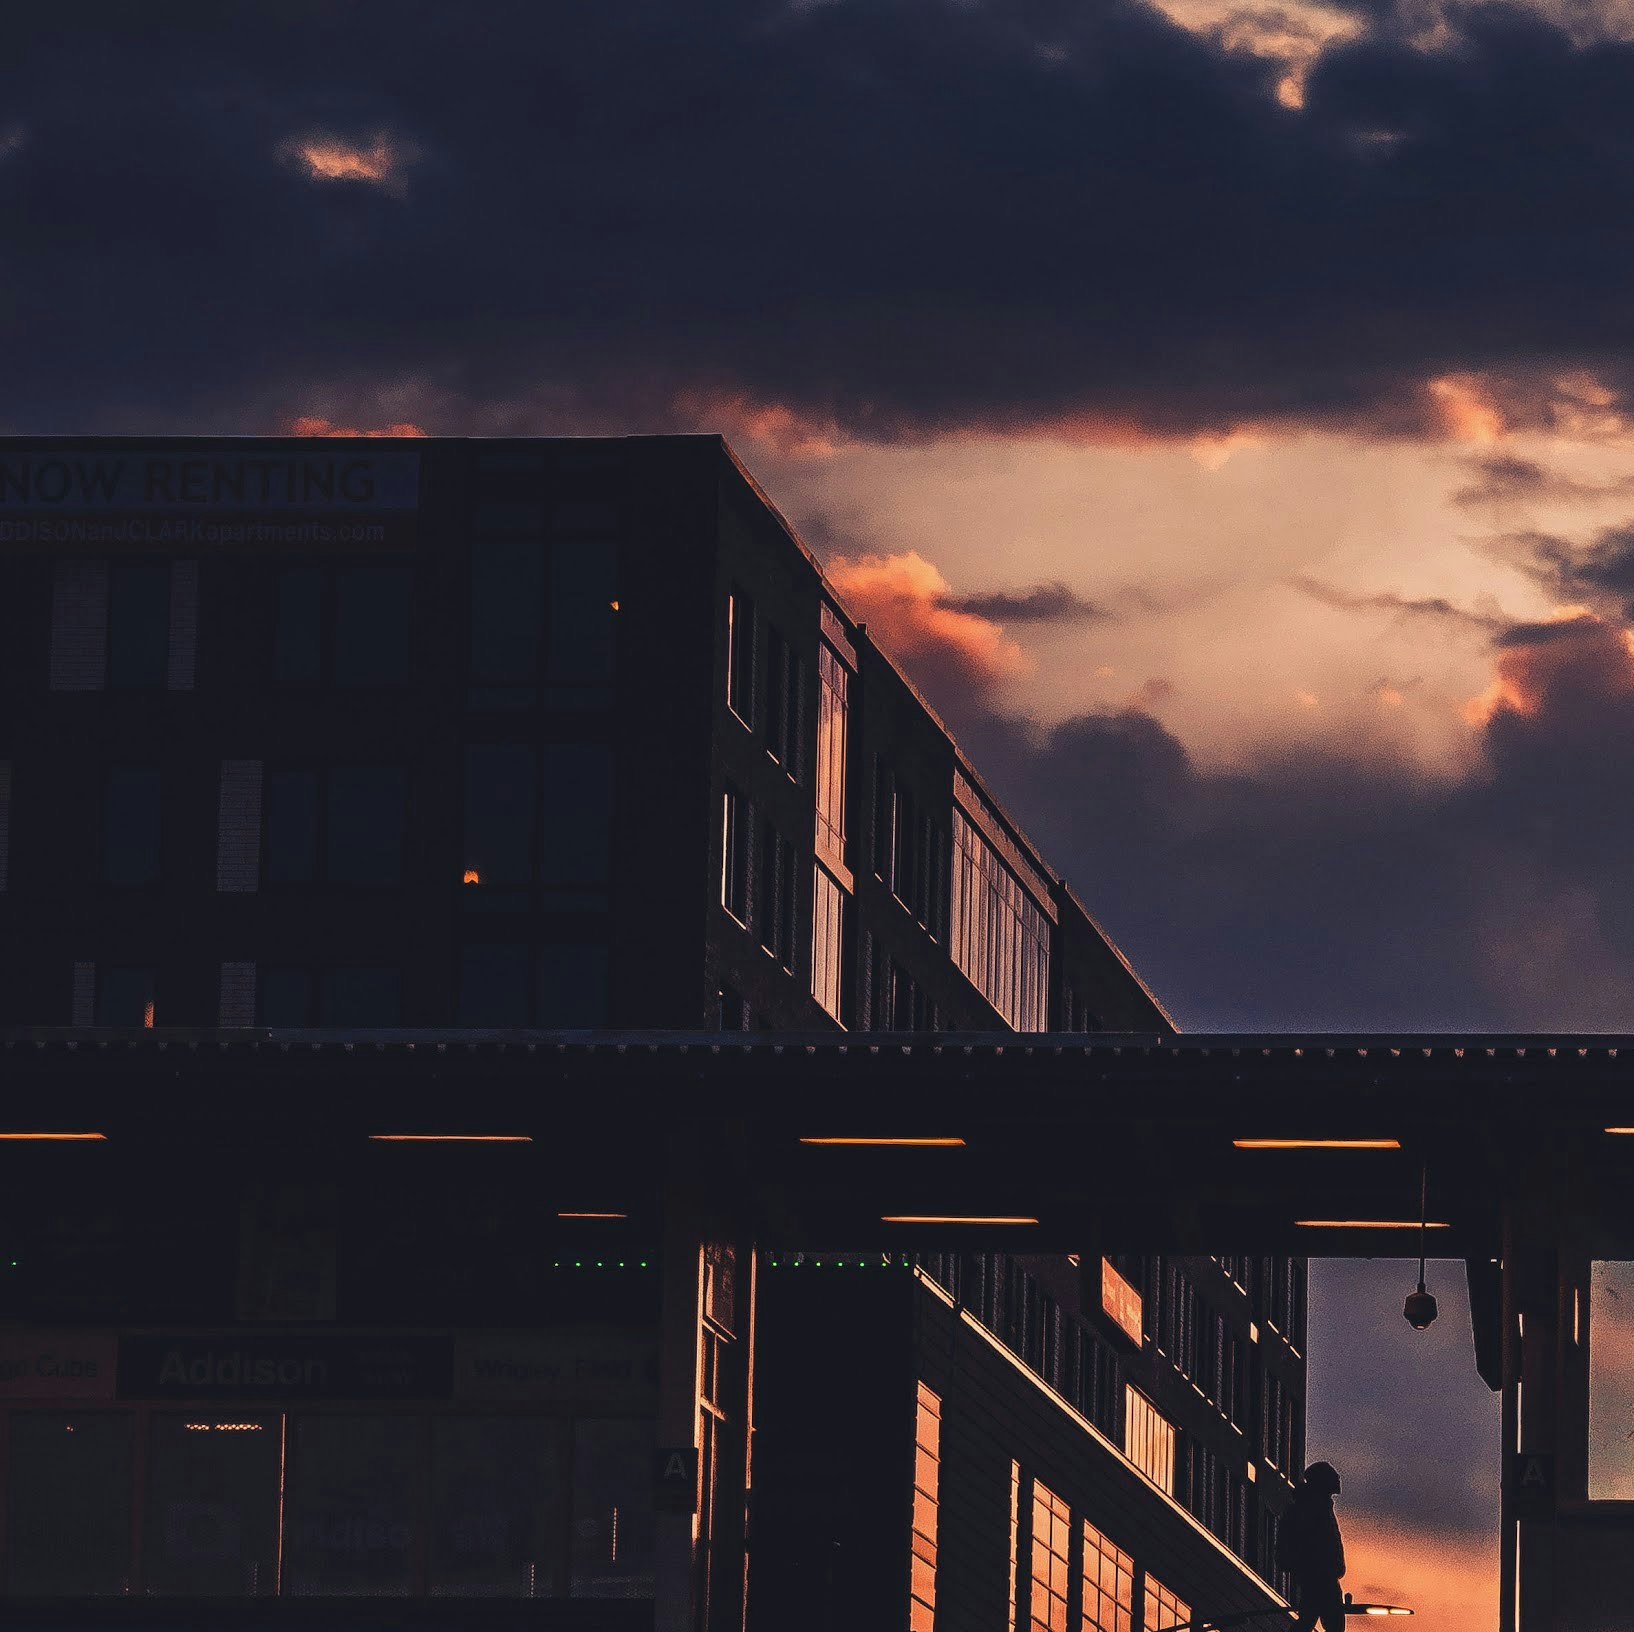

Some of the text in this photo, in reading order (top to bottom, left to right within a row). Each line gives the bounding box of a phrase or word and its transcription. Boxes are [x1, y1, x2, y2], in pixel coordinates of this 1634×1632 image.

[143, 459, 375, 503] RENTING
[158, 1349, 328, 1386] Addison
[663, 1454, 687, 1479] A
[1522, 1458, 1546, 1486] A
